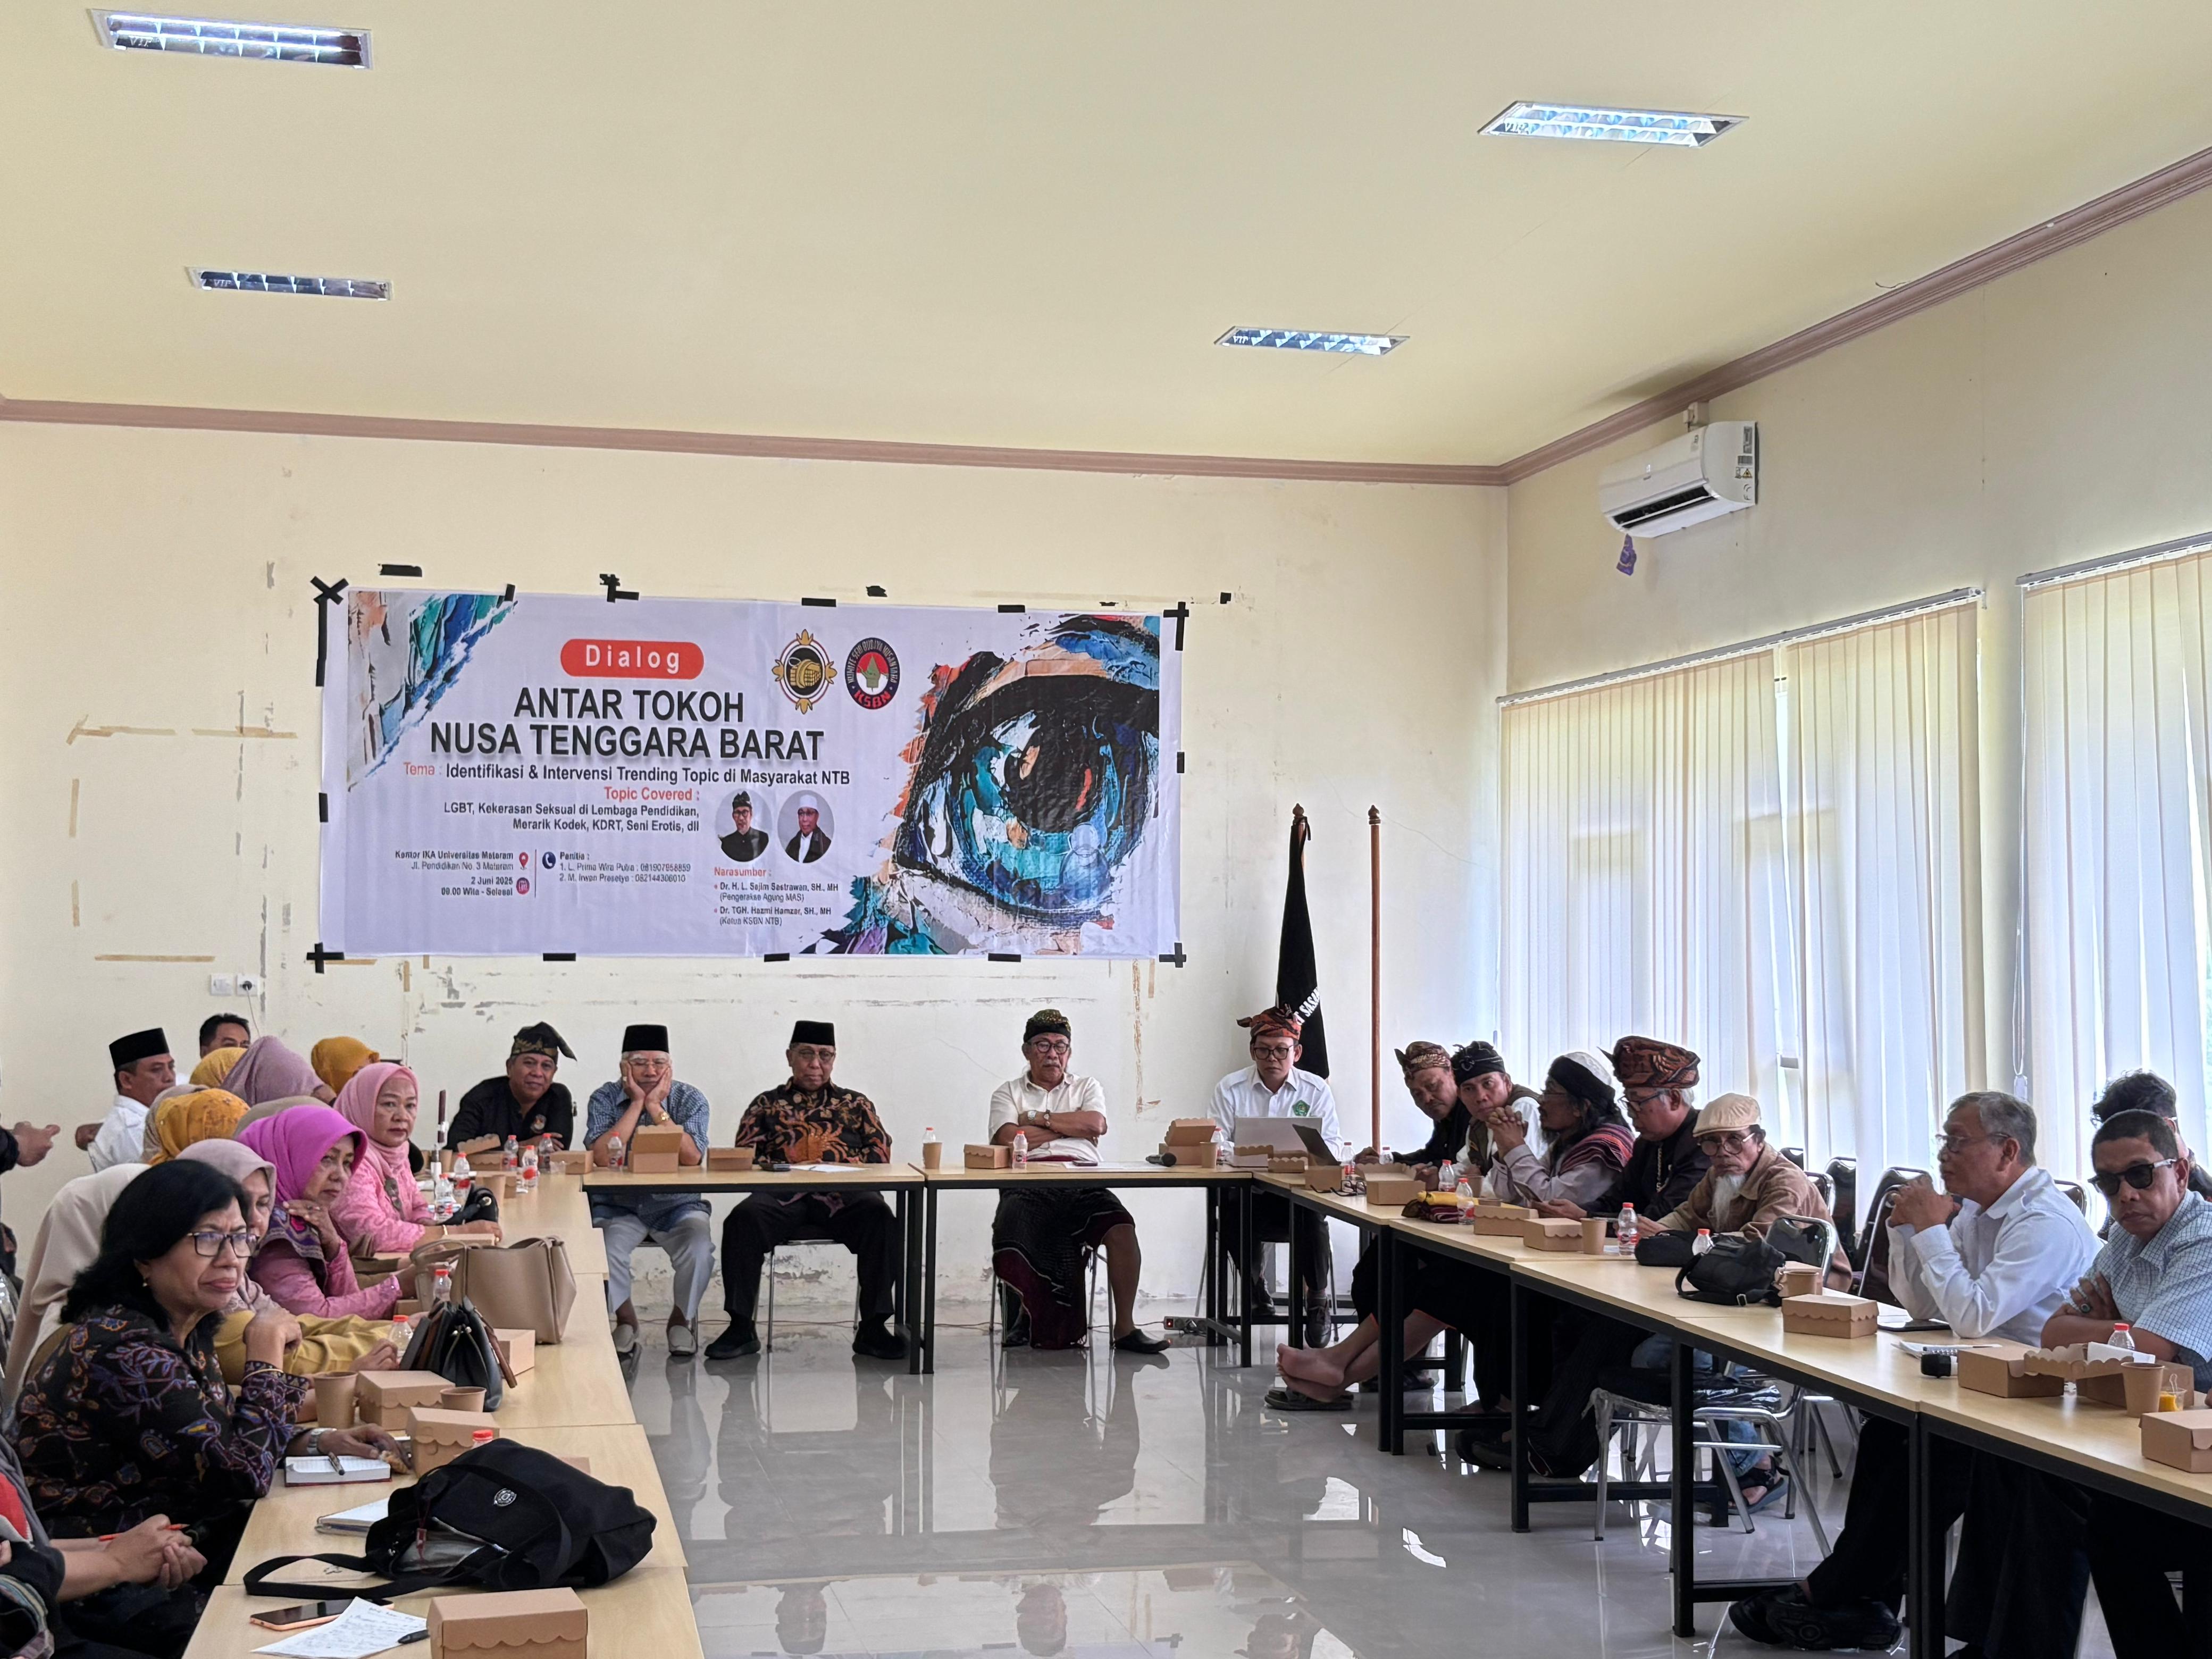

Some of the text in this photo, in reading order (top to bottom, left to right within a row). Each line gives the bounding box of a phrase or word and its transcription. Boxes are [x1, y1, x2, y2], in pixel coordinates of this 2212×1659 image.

[586, 644, 679, 674] Dialog
[514, 687, 744, 723] ANTAR TOKOH
[854, 690, 892, 709] KSBN
[431, 722, 825, 760] NUSA TENGGARA BARAT
[403, 761, 435, 776] Tema
[446, 763, 524, 780] Identifikasi
[528, 765, 539, 780] &
[543, 765, 612, 781] Intervensi
[617, 766, 678, 785] Trending
[682, 767, 719, 785] Topic
[724, 768, 736, 783] di
[741, 768, 818, 787] Masyarakat
[822, 770, 850, 785] NTB
[604, 786, 638, 802] Topic
[641, 786, 693, 801] Covered
[444, 802, 699, 818] LGBT, Kekerasan Seksual di Lembaga Pendidikan,
[513, 818, 699, 833] Merarik Kodek, KDRT, Seni Erotis, dll
[422, 851, 437, 860] IKA
[714, 867, 767, 877] Narasumber
[477, 876, 493, 885] Juni
[720, 882, 730, 891] Dr.
[720, 906, 730, 914] Dr.
